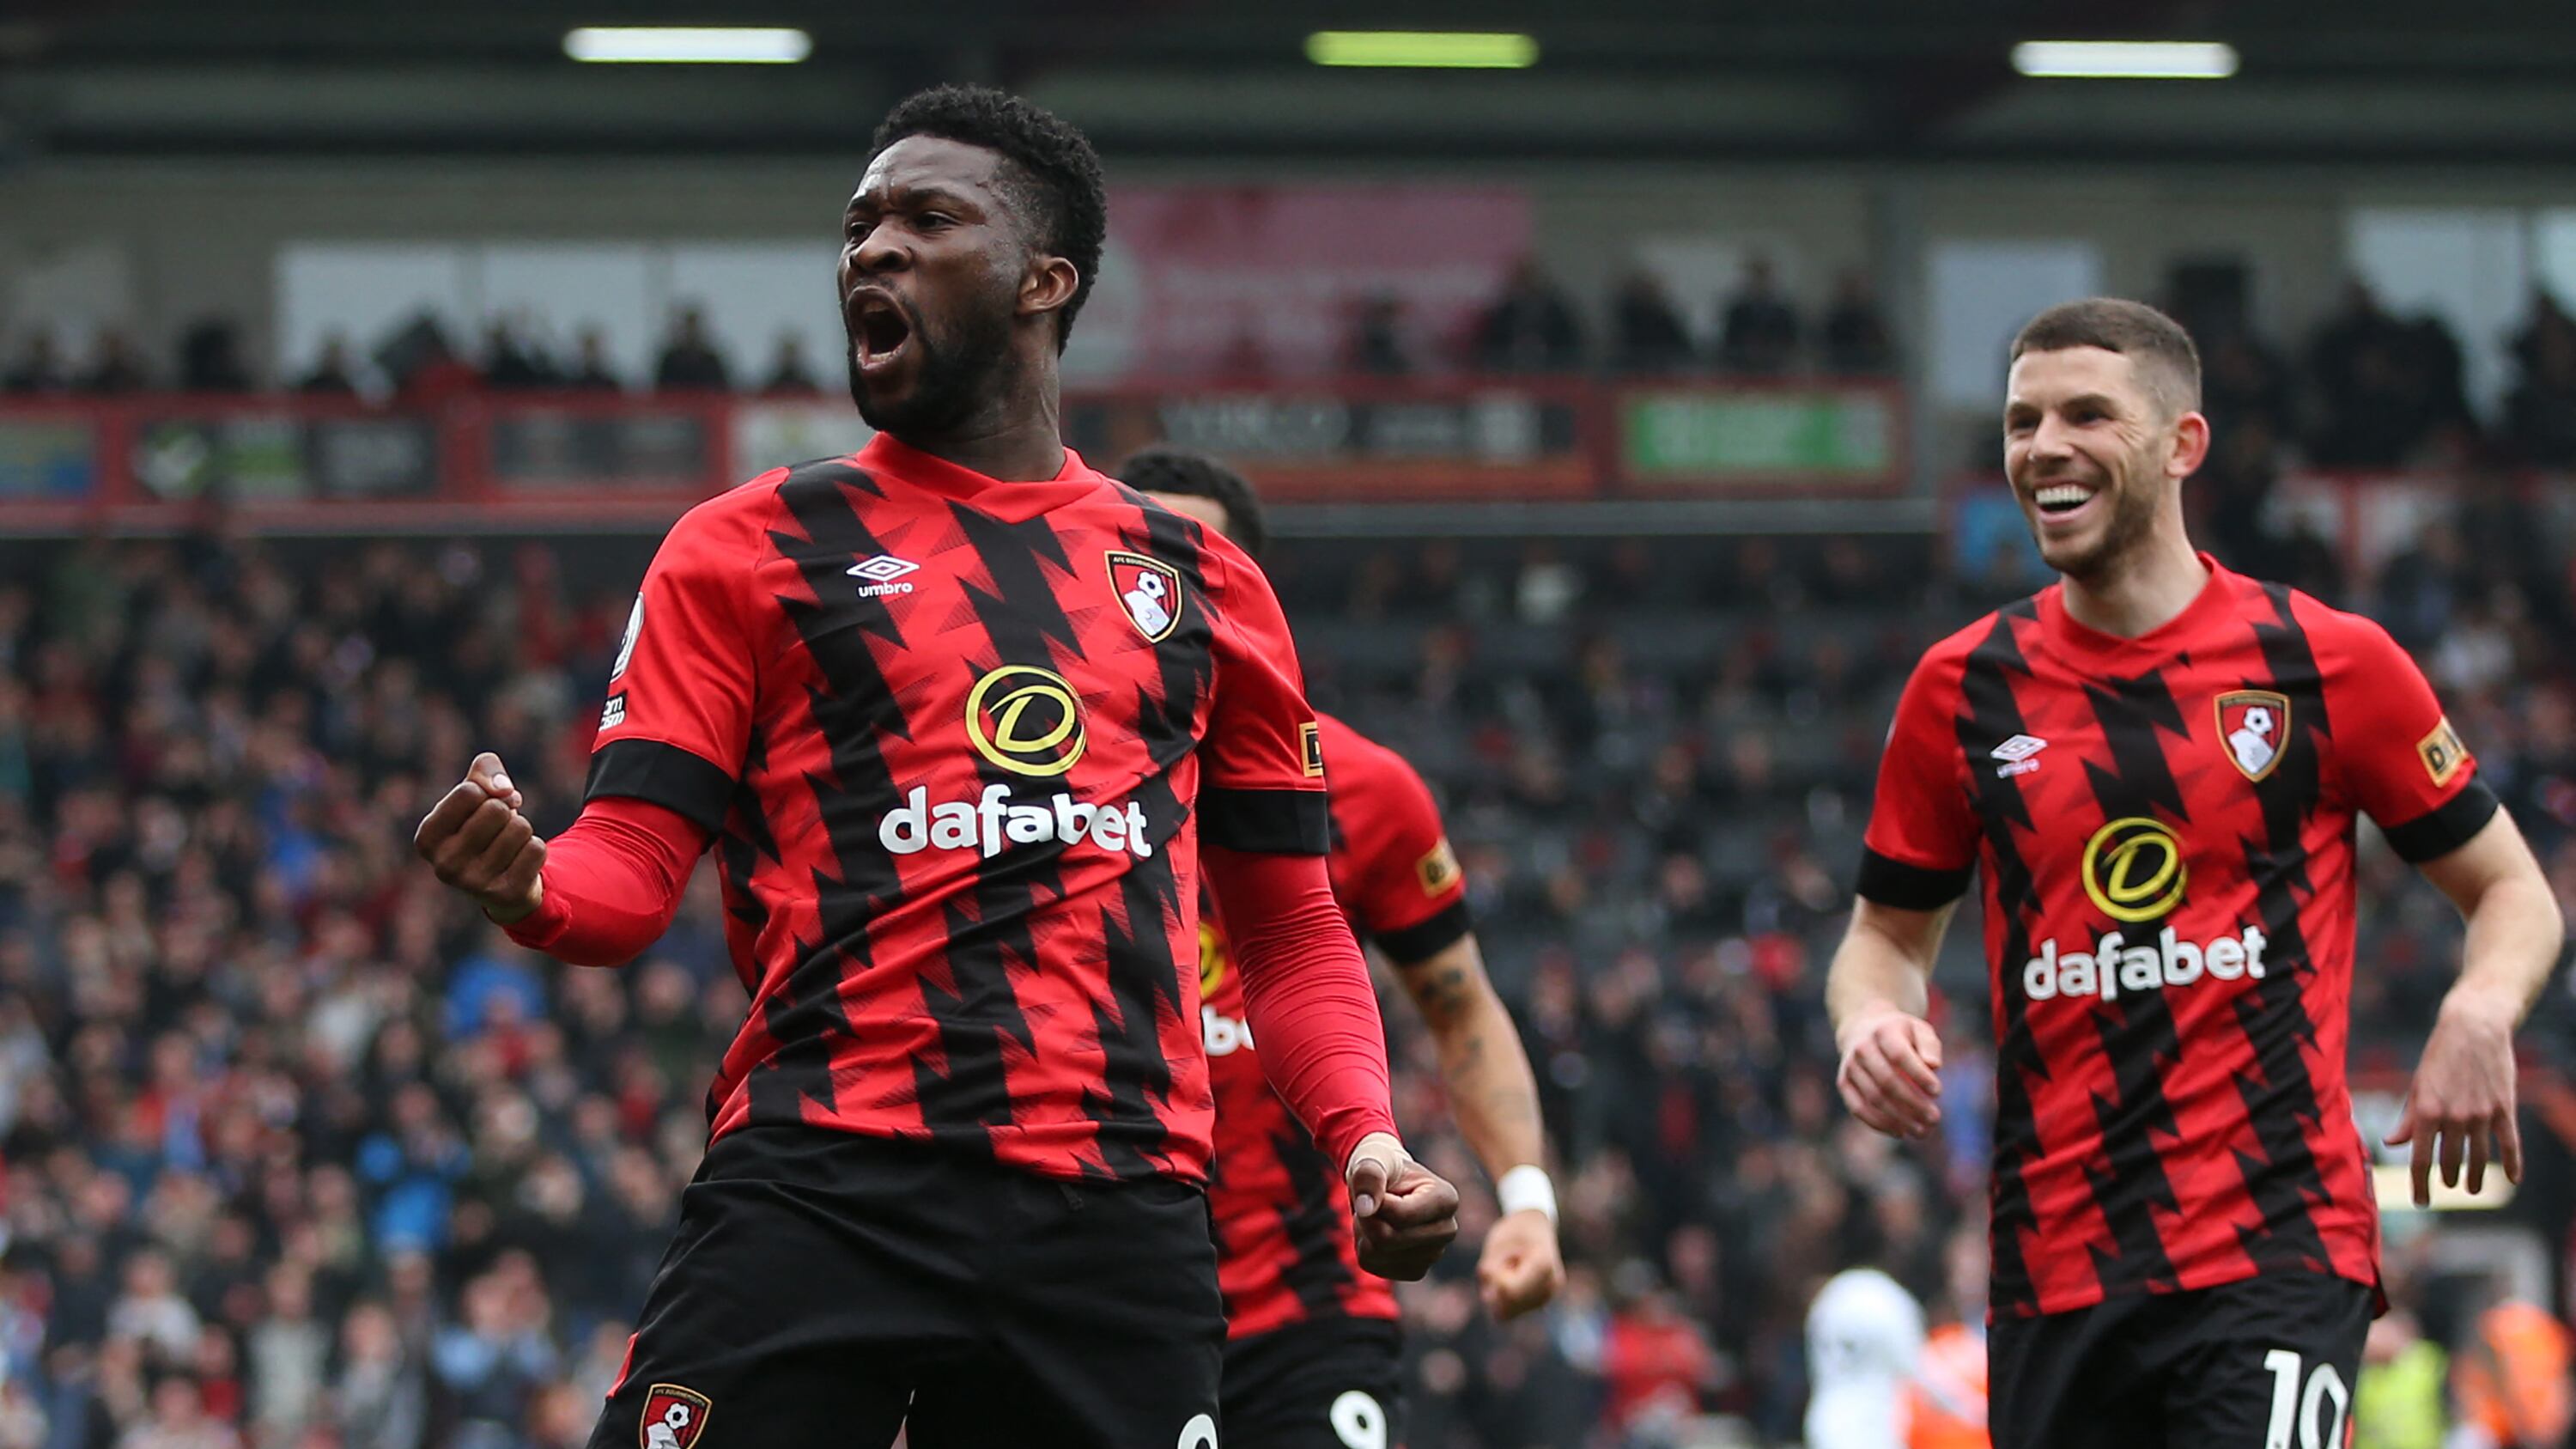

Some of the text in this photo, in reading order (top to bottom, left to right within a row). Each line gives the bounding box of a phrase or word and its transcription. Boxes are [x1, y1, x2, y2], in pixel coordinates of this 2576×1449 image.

[859, 582, 913, 597] umbro
[878, 783, 1152, 859] dafabet
[2023, 924, 2267, 1002] dafabet
[2263, 1349, 2348, 1449] 10
